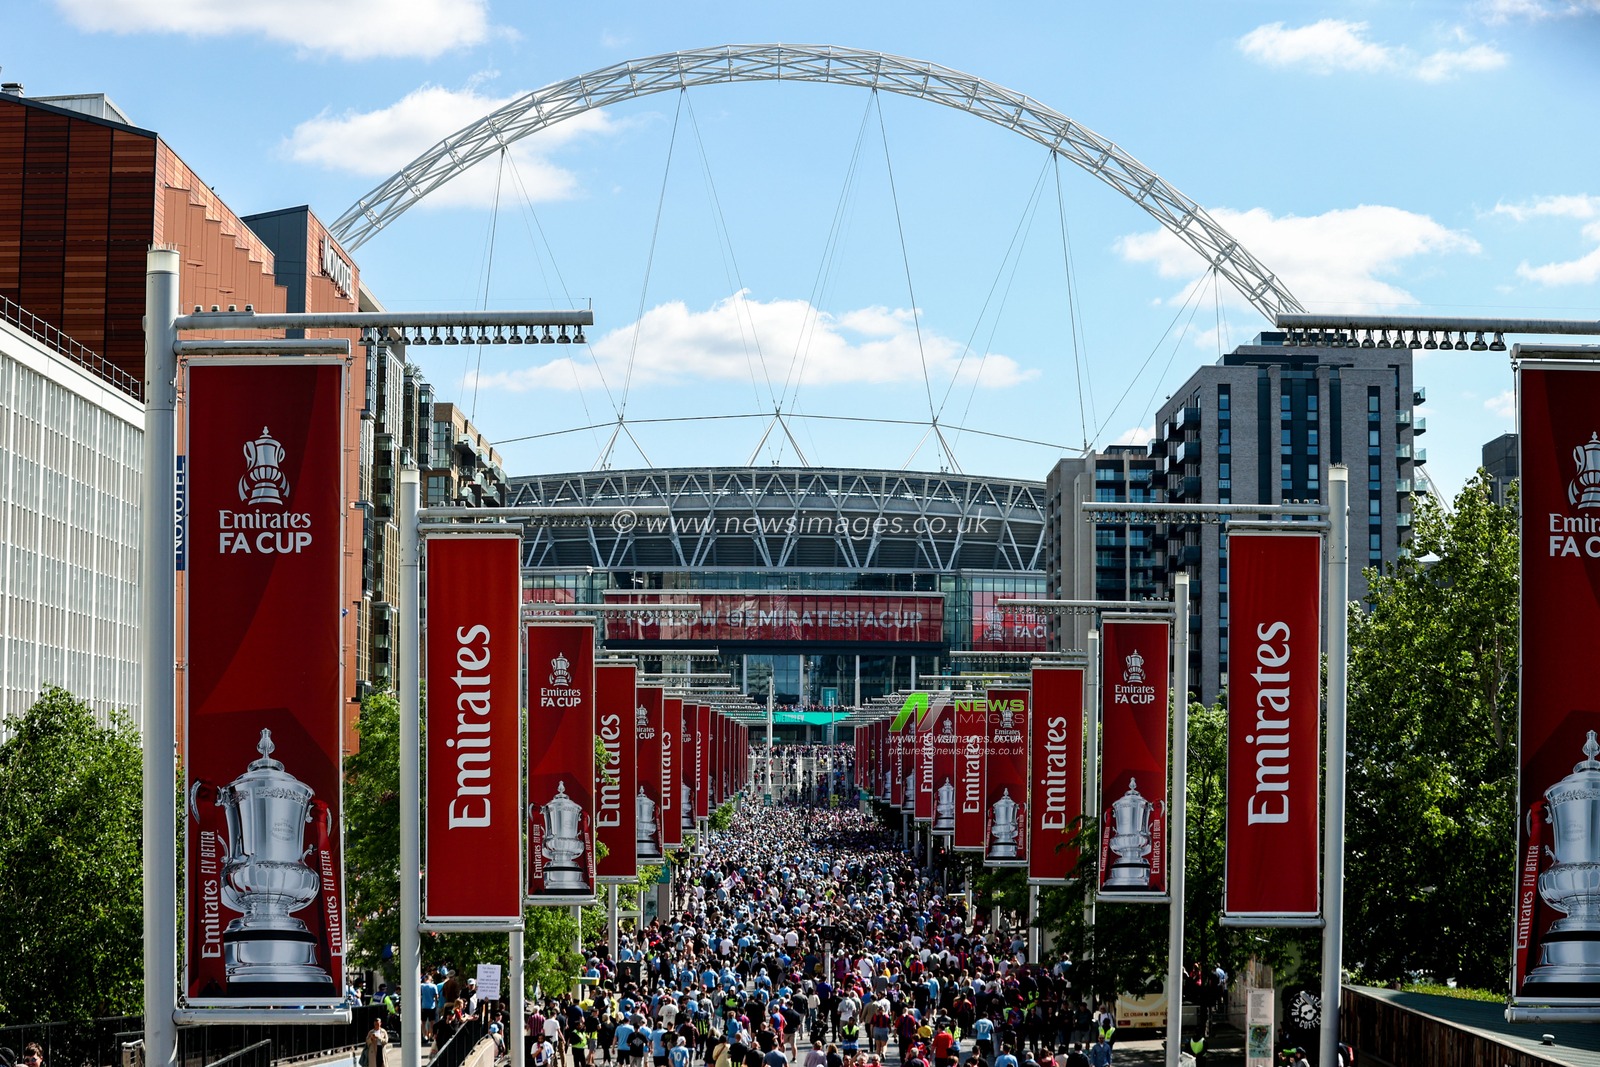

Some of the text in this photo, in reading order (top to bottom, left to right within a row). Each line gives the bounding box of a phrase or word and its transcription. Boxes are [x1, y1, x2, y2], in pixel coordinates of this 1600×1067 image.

[323, 236, 354, 300] NOVOTEL
[219, 509, 312, 528] Emirates
[1549, 513, 1600, 532] Emir
[220, 532, 312, 554] FA CUP
[1550, 536, 1600, 558] FA C
[726, 610, 923, 628] @EMIRATESFACUP
[1014, 626, 1031, 638] FA
[540, 687, 580, 697] Emirates
[1115, 684, 1154, 694] Emirates
[1115, 694, 1155, 704] FA CUP
[540, 698, 582, 707] FA CUP
[446, 624, 490, 830] Emirates
[1246, 621, 1290, 826] Emirates
[962, 734, 980, 814] Emirates
[1041, 716, 1066, 830] Emirates
[534, 845, 542, 878] Emirates
[1151, 841, 1160, 874] Emirates
[201, 831, 222, 959] Emirates FLY BETTER
[321, 850, 342, 957] Emirates FLY BETTER
[1517, 845, 1539, 950] Emirates FLY BETTER
[980, 1024, 988, 1033] 17
